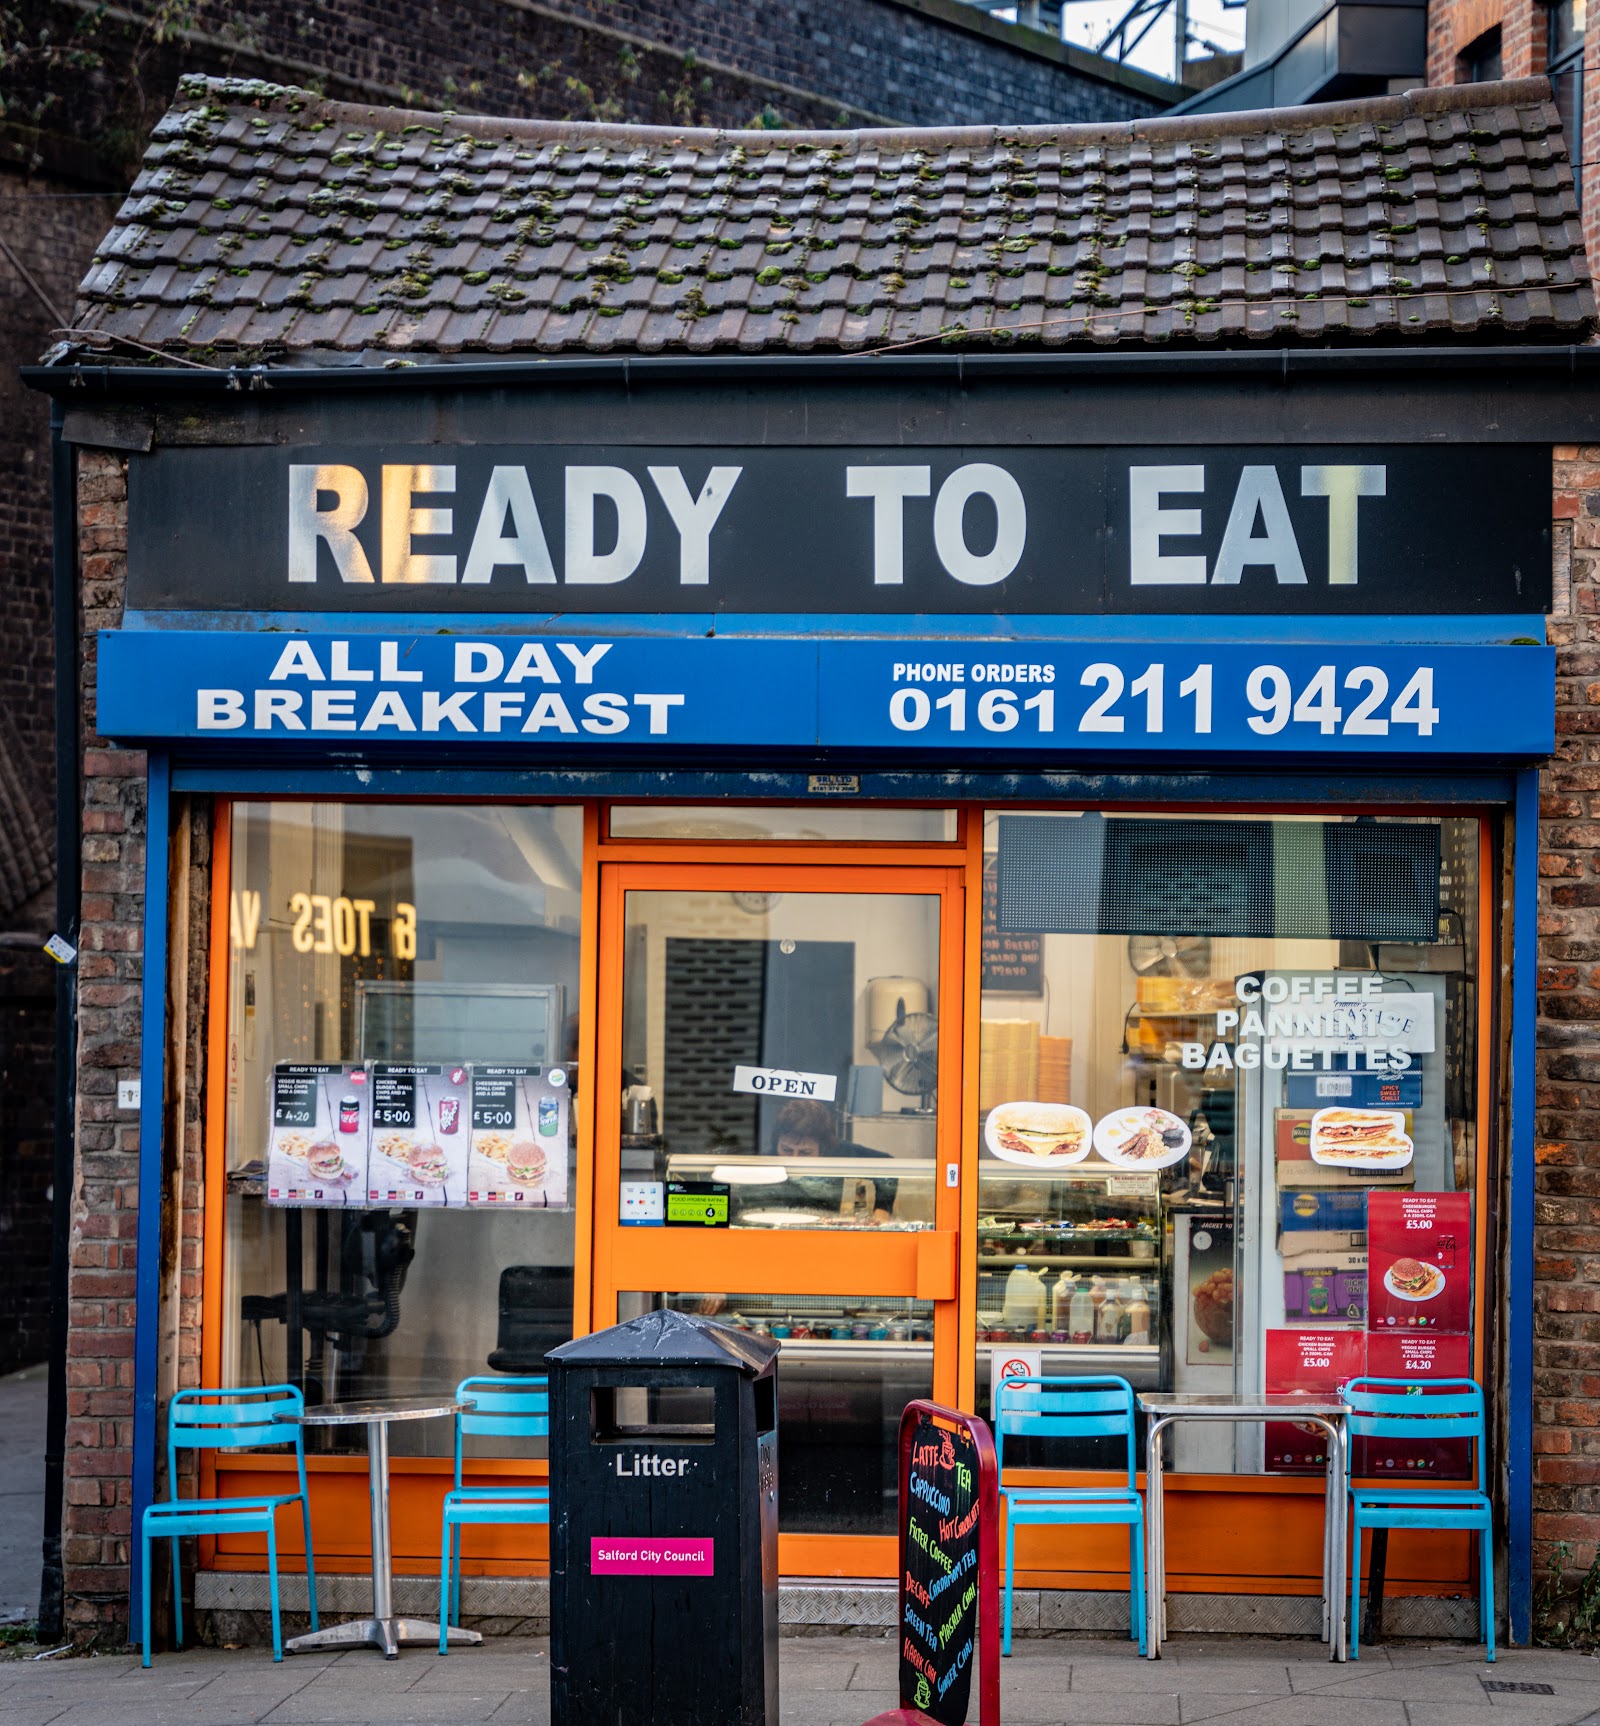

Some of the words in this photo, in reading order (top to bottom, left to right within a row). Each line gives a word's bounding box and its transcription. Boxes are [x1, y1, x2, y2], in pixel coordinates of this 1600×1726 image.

[288, 463, 743, 585] READY
[845, 463, 1027, 586] TO
[1129, 464, 1387, 586] EAT
[269, 640, 424, 682] ALL
[454, 642, 614, 685] DAY
[892, 663, 966, 683] PHONE
[971, 663, 1057, 684] ORDERS
[196, 688, 686, 736] BREAKFAST
[888, 688, 1056, 733] 0161
[1079, 662, 1214, 734] 211
[1246, 664, 1440, 737] 9424
[1235, 976, 1384, 1003] COFFEE
[1216, 1010, 1404, 1037] PANNINIS
[1182, 1042, 1412, 1070] BAGUETTES
[751, 1075, 817, 1096] OPEN
[1406, 1220, 1433, 1229] £5.00
[1303, 1358, 1330, 1367] £5.00
[1406, 1360, 1431, 1369] £4.20
[616, 1453, 690, 1476] Litter
[912, 1441, 940, 1466] LATTE
[956, 1462, 972, 1492] TEA
[910, 1471, 951, 1517] CAPPUCCINO
[939, 1518, 954, 1542] HOT
[598, 1550, 638, 1561] Salford
[640, 1550, 661, 1563] City
[664, 1550, 704, 1561] Council
[909, 1516, 928, 1553] FILTER
[930, 1540, 952, 1574] COFFEE
[962, 1548, 976, 1572] TEA
[904, 1603, 925, 1638] GREEN
[925, 1623, 938, 1652] TEA
[939, 1604, 963, 1650] MASALA
[962, 1582, 976, 1611] CHAI
[924, 1660, 937, 1685] CHAI
[937, 1662, 958, 1702] GINGER
[957, 1638, 973, 1669] CHAI
